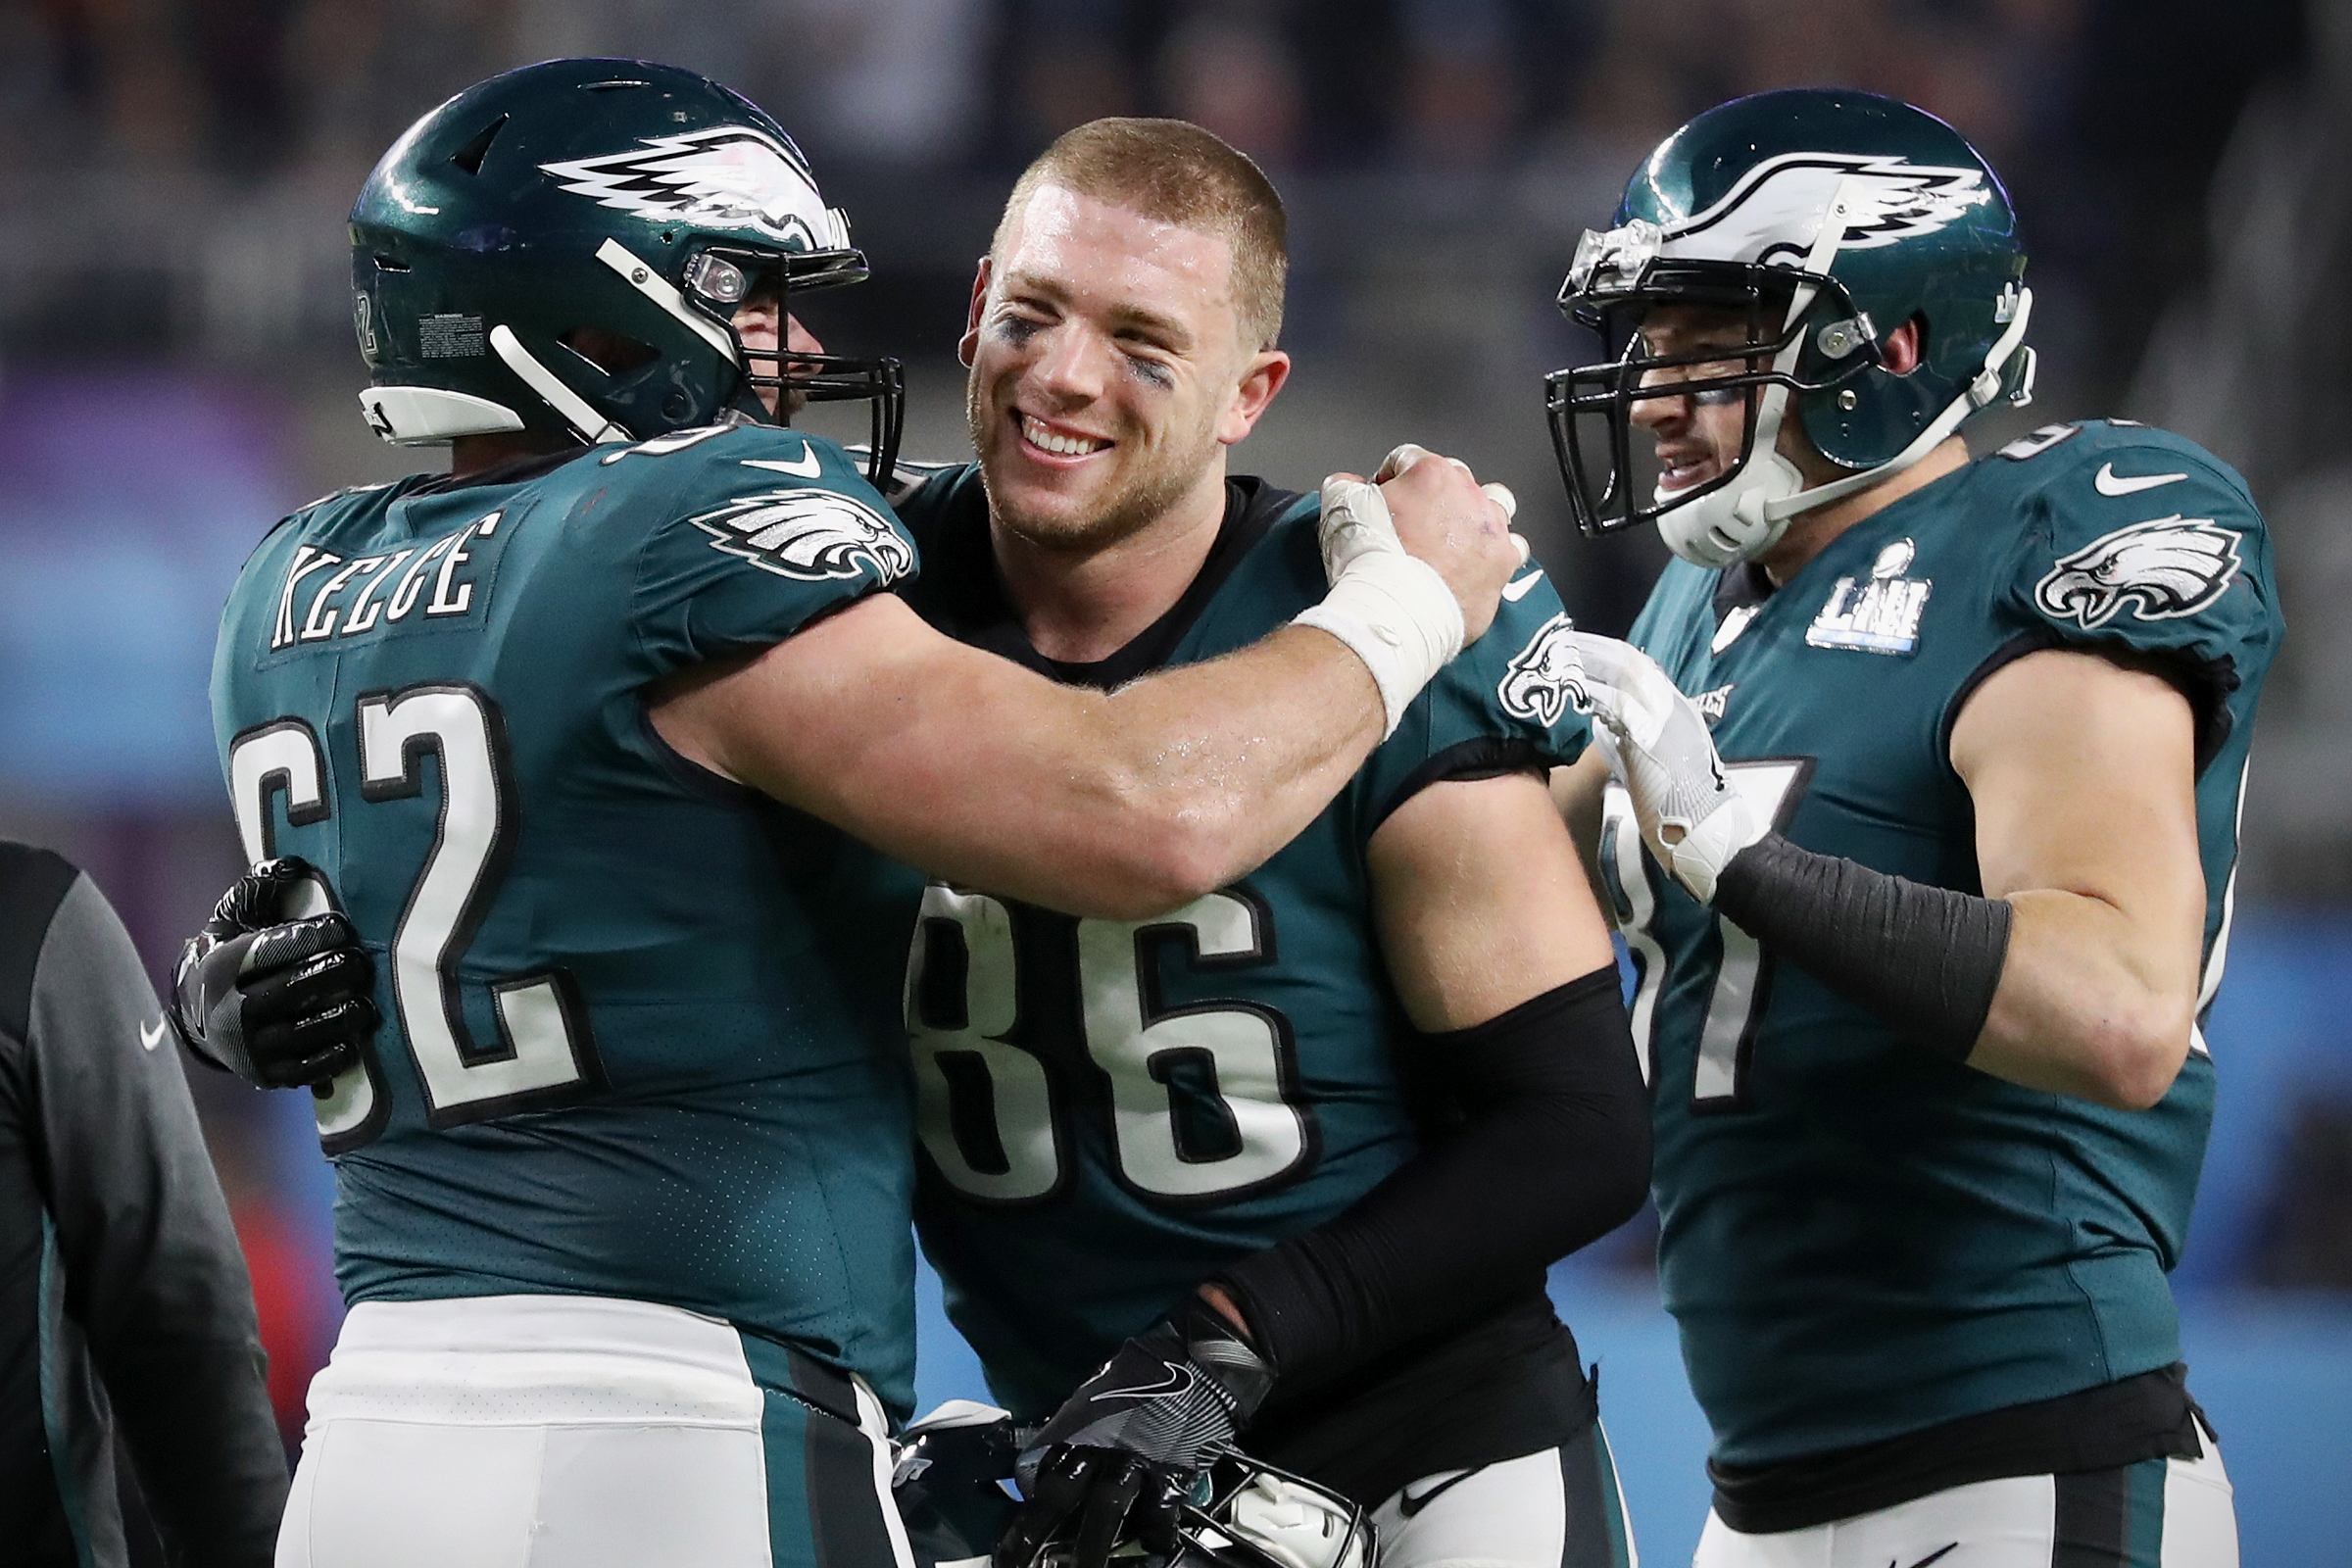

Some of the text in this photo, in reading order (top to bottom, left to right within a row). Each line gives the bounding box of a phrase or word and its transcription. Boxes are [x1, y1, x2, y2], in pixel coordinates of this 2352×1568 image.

[355, 290, 379, 359] 2
[270, 511, 506, 654] KELCE
[903, 879, 1318, 1207] 86
